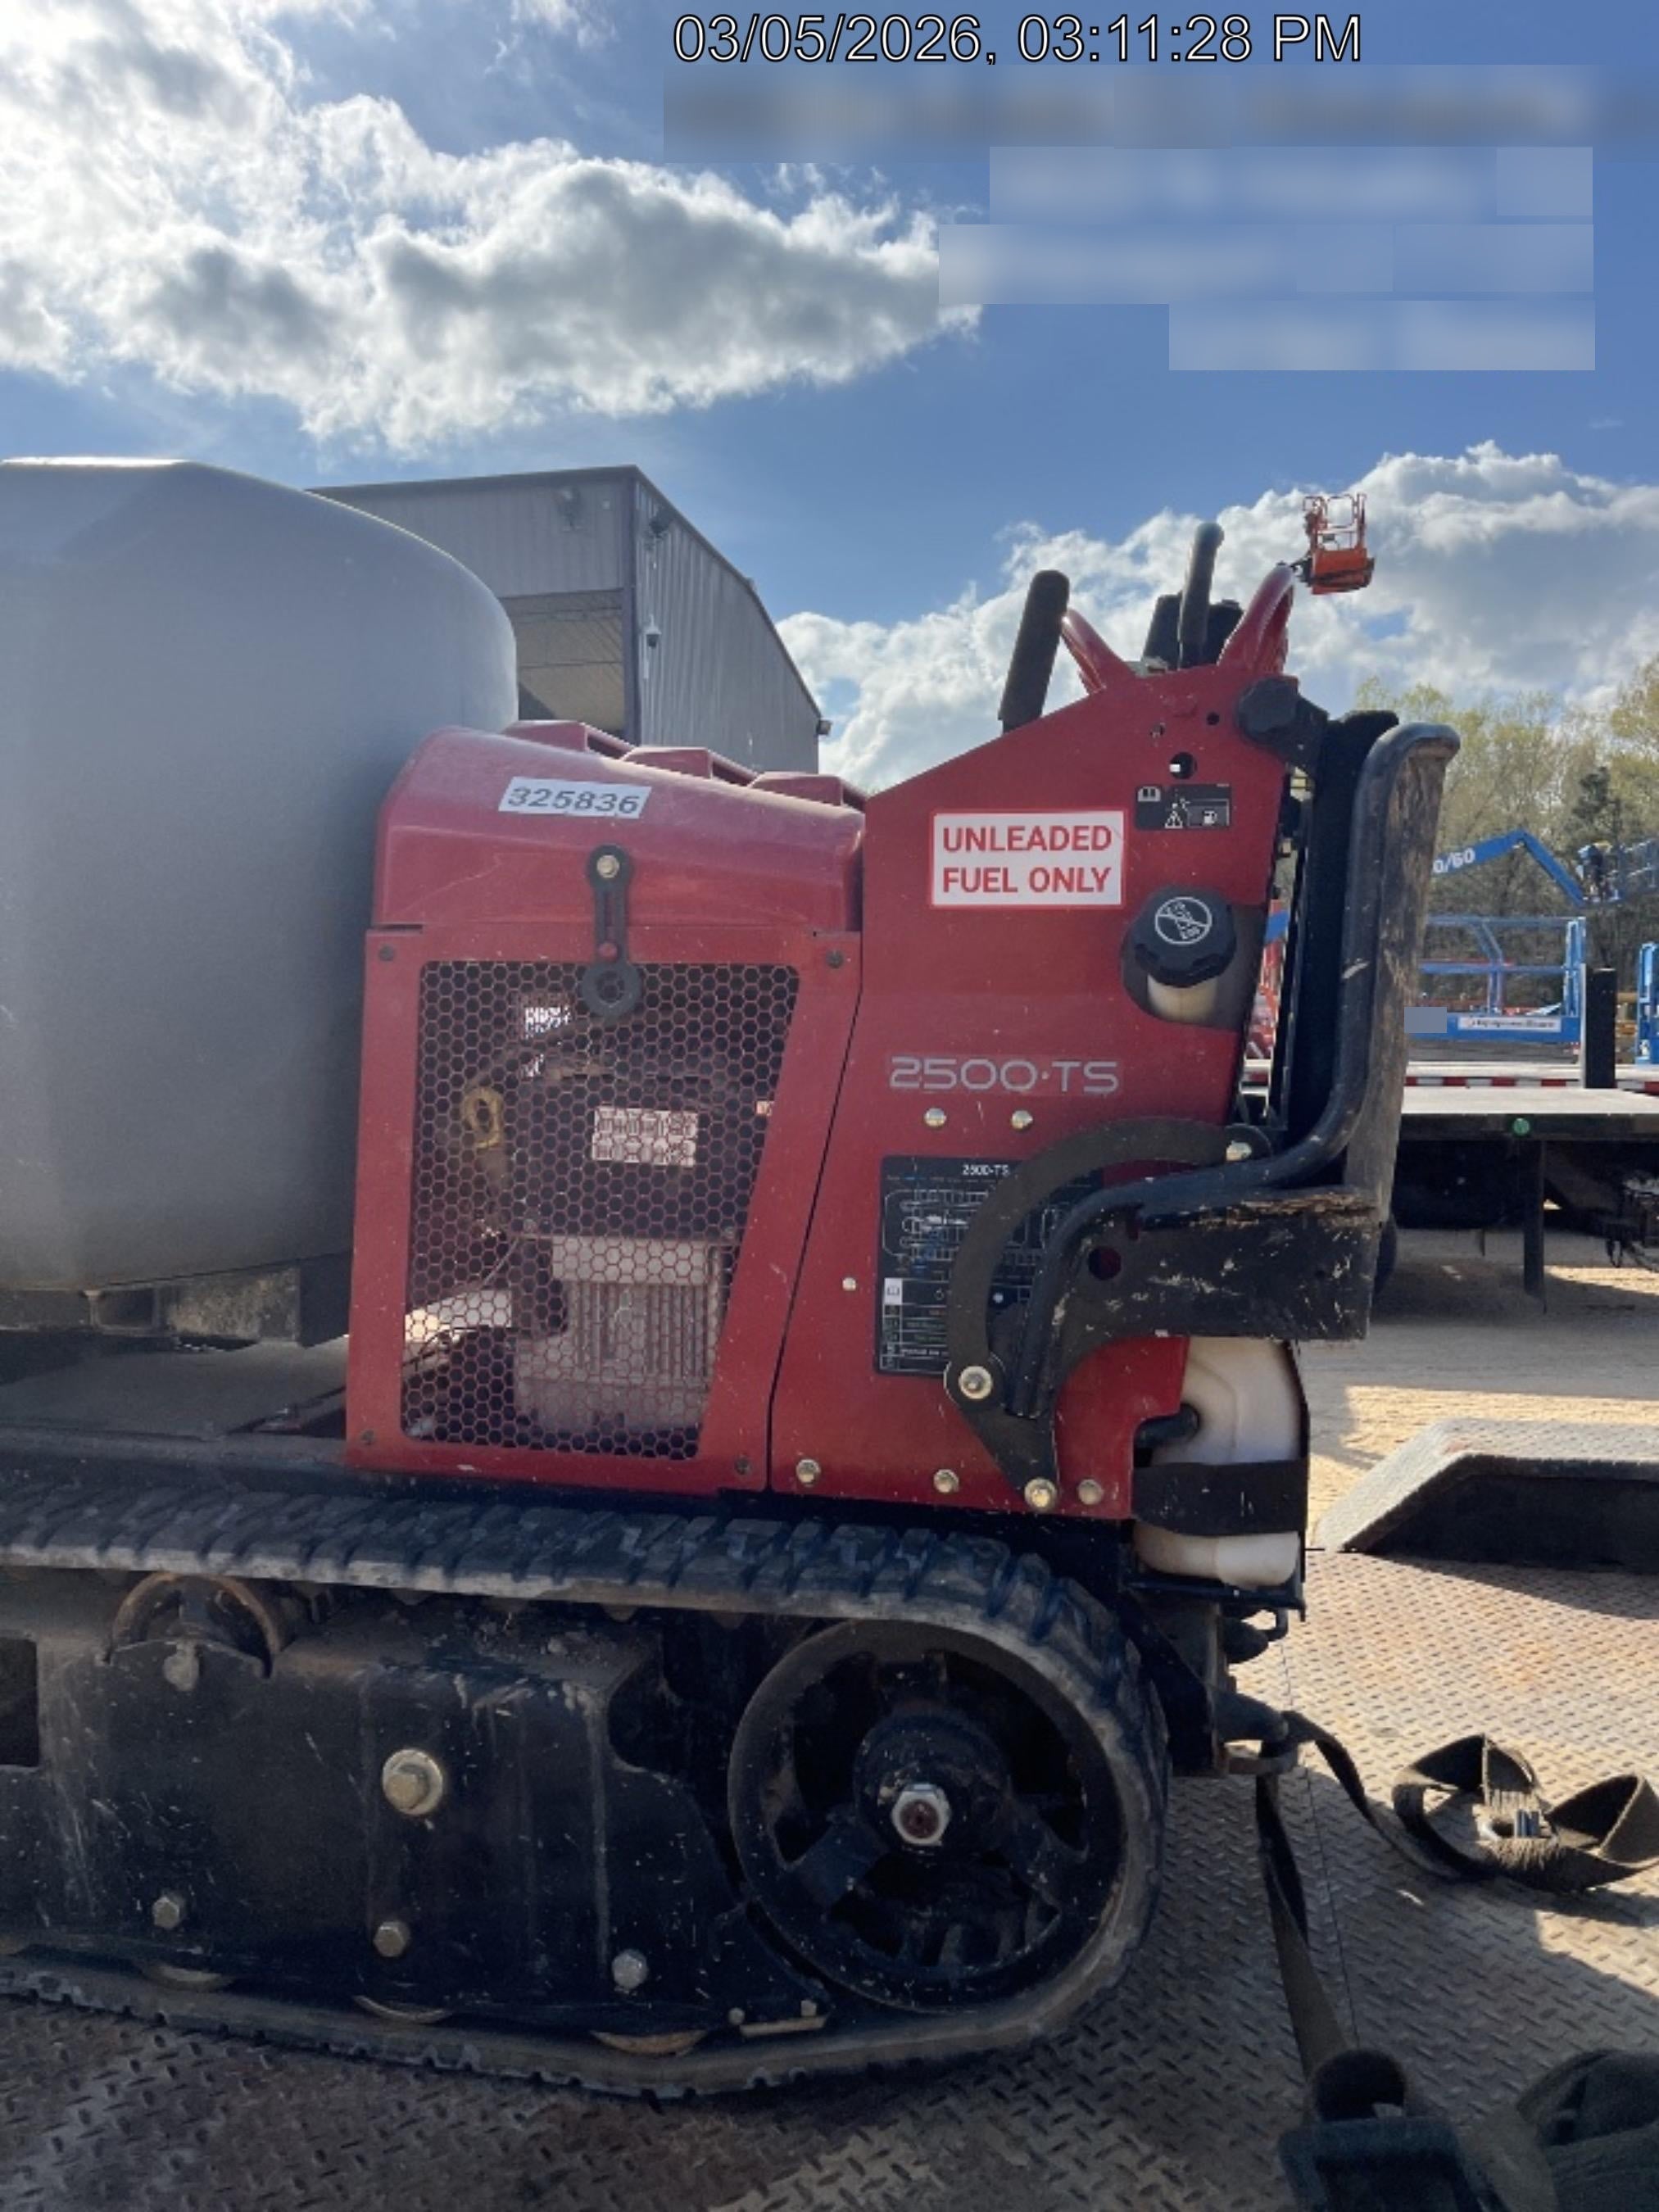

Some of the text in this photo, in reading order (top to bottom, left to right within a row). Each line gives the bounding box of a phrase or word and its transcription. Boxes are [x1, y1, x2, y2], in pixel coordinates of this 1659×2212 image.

[508, 786, 640, 814] 325836
[943, 825, 1113, 852] UNLEADED
[943, 867, 1112, 893] FUEL ONLY
